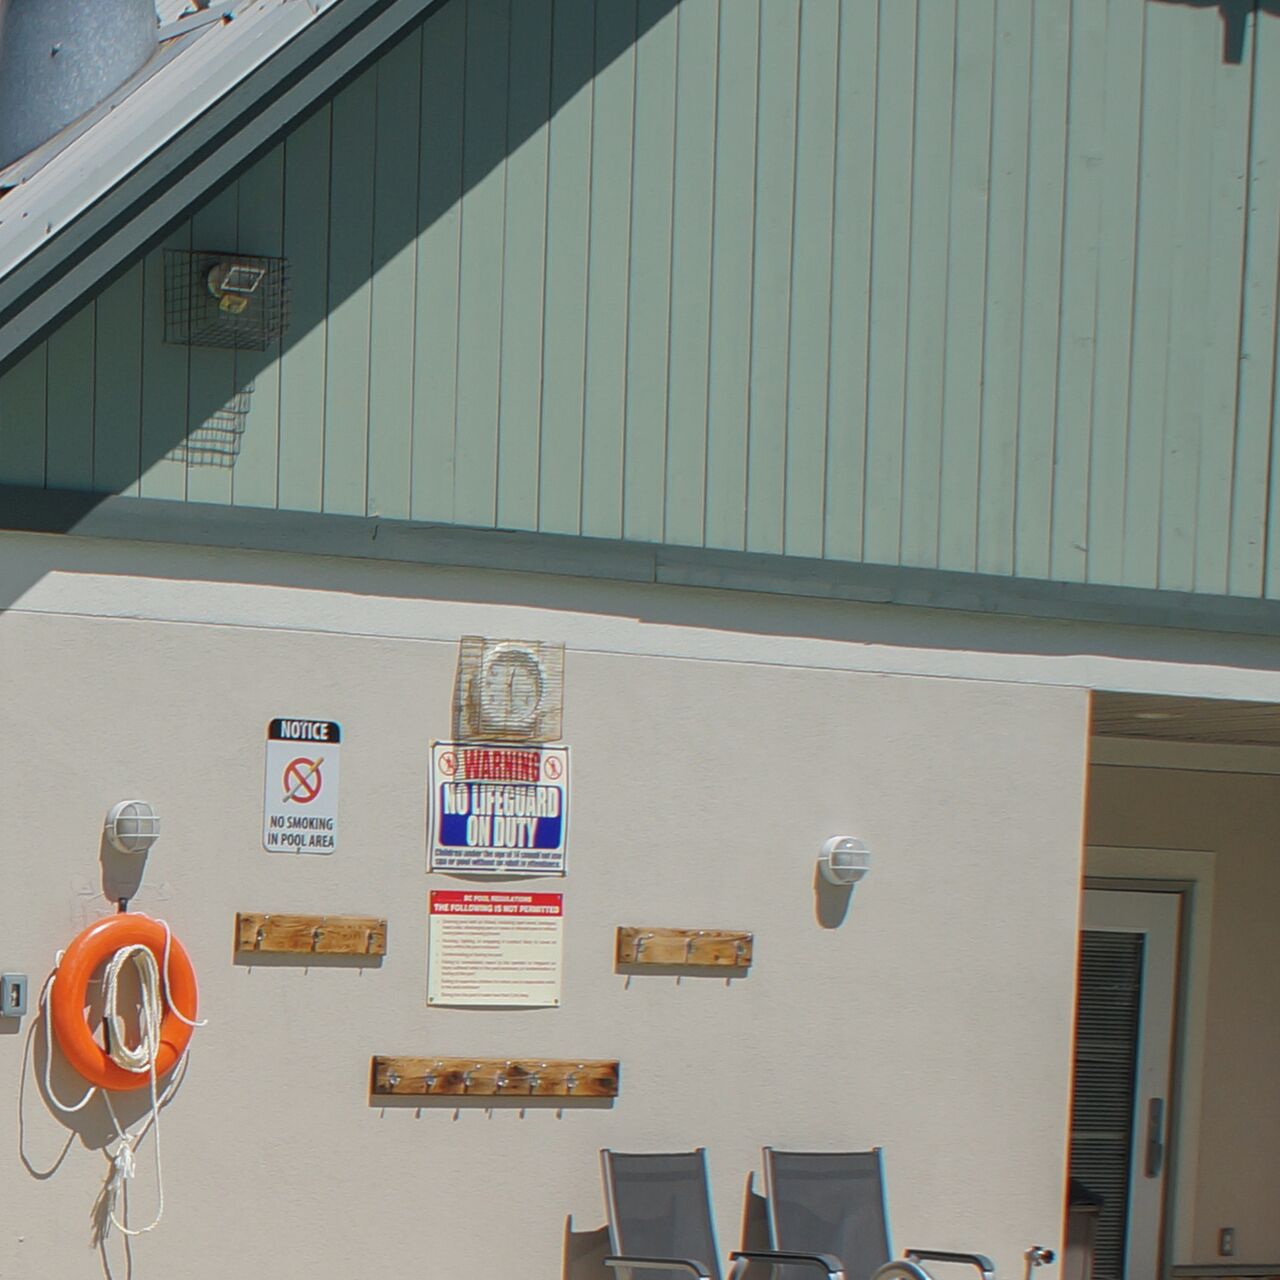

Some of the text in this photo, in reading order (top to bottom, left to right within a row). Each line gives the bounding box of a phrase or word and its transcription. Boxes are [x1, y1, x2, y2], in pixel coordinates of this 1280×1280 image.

[280, 720, 329, 740] NOTICE
[463, 749, 541, 782] WARNING
[444, 783, 560, 818] NO LIFEGUARD
[270, 816, 333, 831] NO SMOKING
[466, 815, 538, 848] ON DUTY
[267, 832, 334, 848] IN POOL AREA
[433, 903, 560, 914] THE FOLLOWING IS NOT PERMITTED
